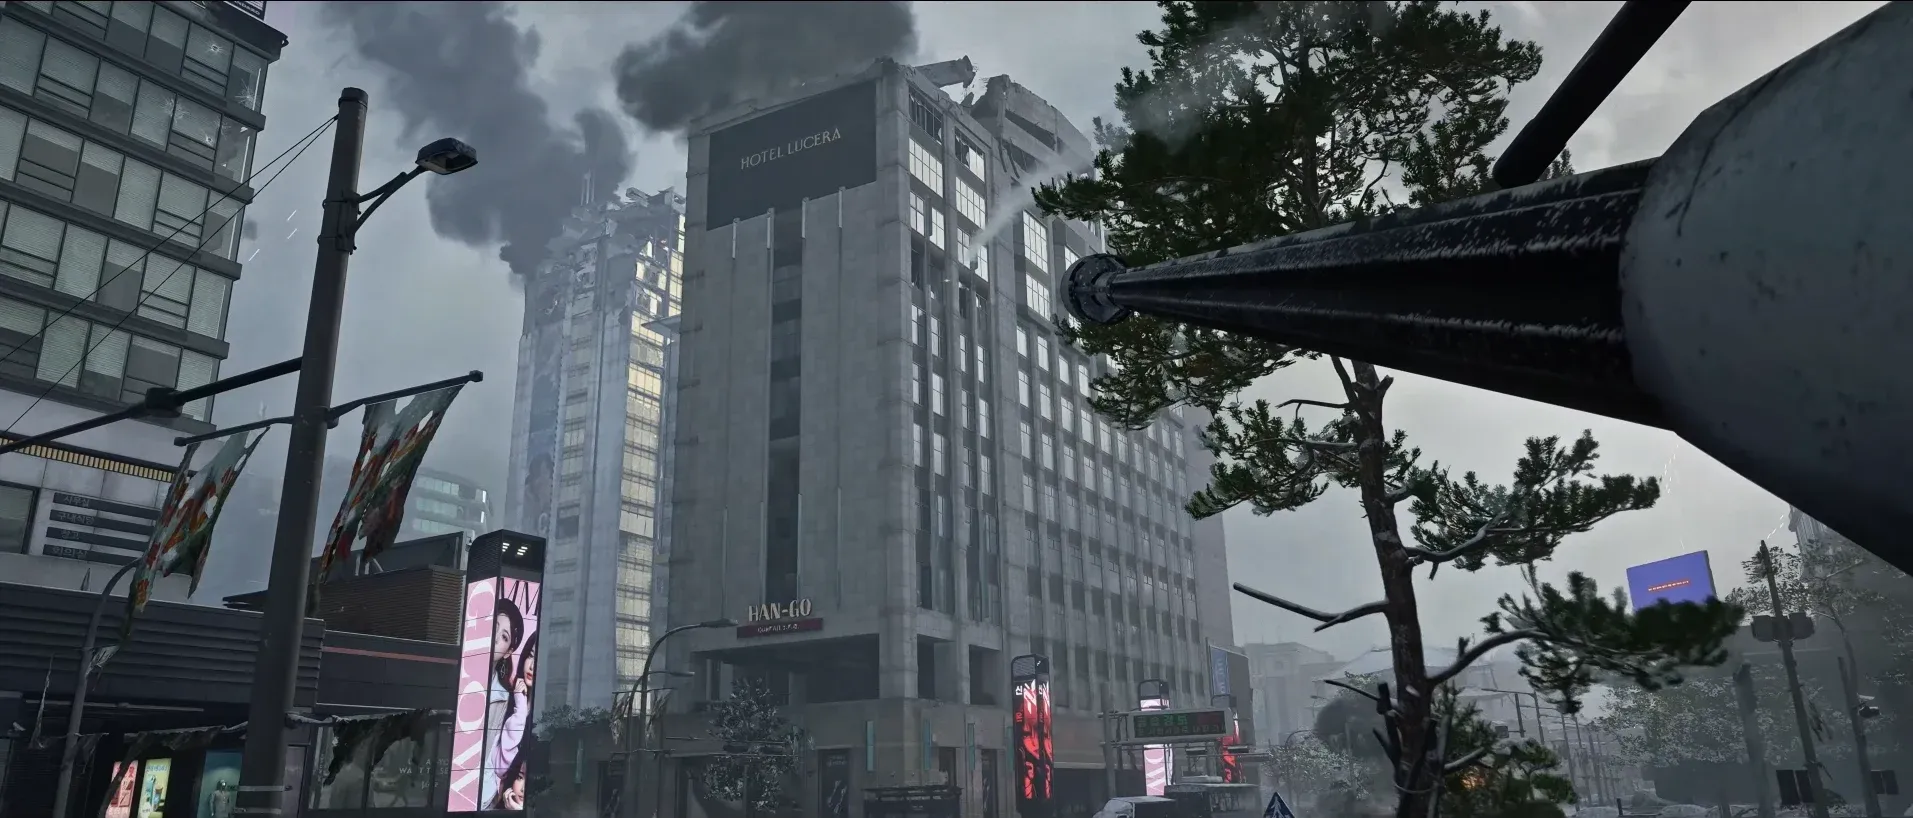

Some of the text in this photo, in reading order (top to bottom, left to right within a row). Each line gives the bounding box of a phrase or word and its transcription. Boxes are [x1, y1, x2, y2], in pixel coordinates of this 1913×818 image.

[740, 127, 841, 170] HOTEL LUCERA
[748, 598, 812, 622] HAN-GO
